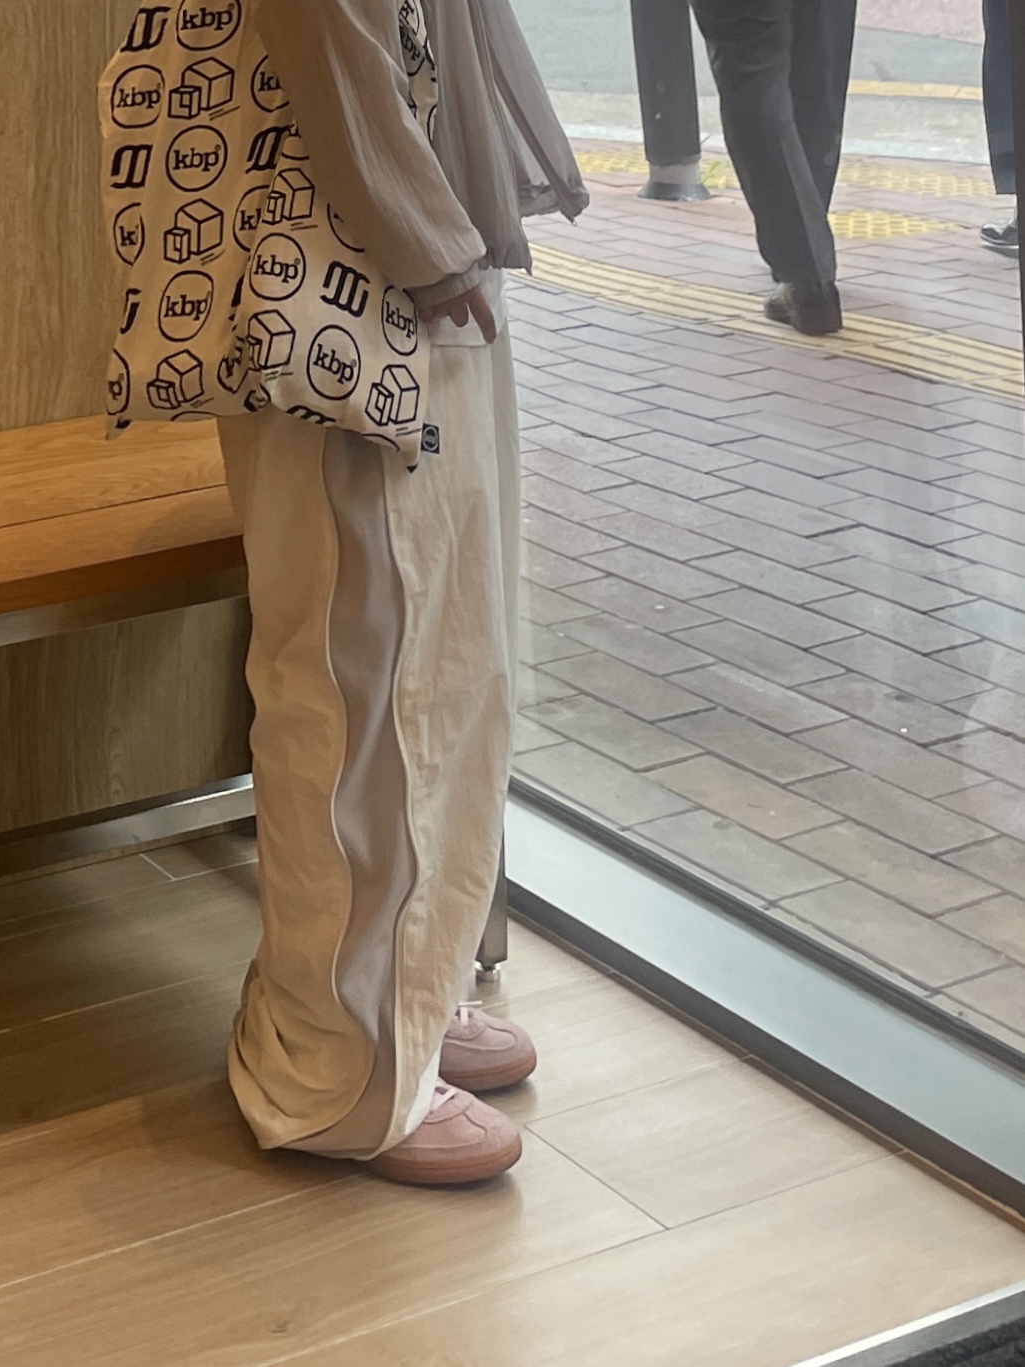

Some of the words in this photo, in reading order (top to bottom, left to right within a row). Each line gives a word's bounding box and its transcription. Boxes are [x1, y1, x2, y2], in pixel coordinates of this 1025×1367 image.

[181, 6, 234, 31] kbp
[116, 86, 161, 109] kbp
[173, 147, 220, 172] kbp
[254, 254, 299, 284] kbp
[163, 294, 209, 321] kbp
[313, 343, 355, 385] kbp
